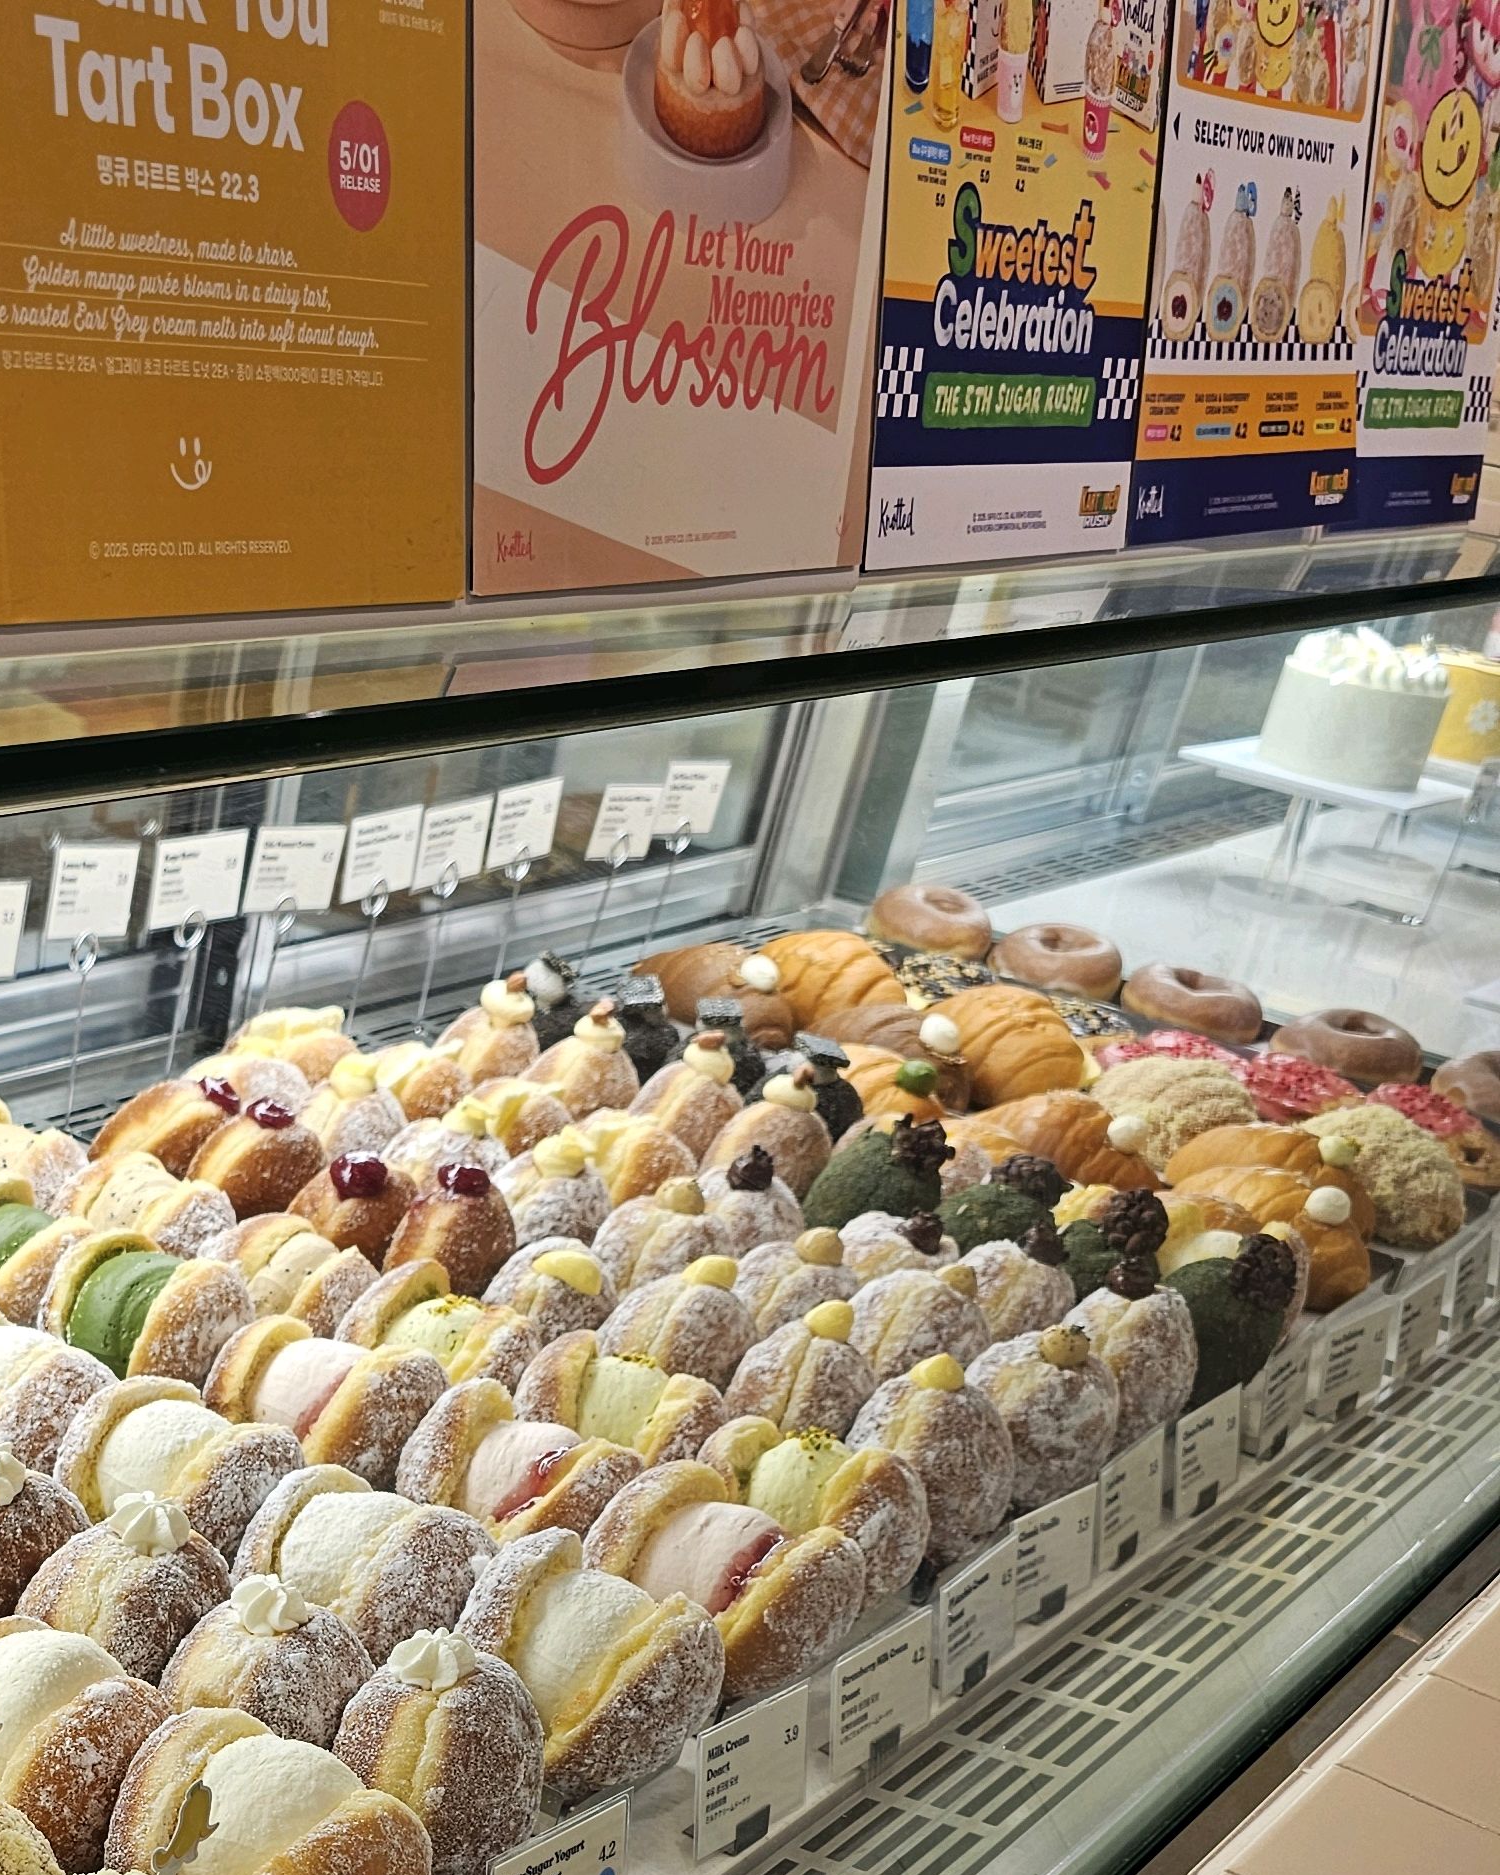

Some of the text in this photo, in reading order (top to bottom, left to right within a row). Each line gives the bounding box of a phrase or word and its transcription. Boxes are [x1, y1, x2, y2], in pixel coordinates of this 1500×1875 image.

[34, 15, 304, 152] Tart Box
[339, 140, 380, 174] 5/01
[1194, 118, 1334, 164] SELECT YOUR OWN DONUT
[97, 155, 260, 203] 땡큐 타르트 박스 22.3
[339, 174, 381, 193] RELEASE
[60, 217, 298, 267] A little sweetness, made to share.
[685, 214, 793, 277] Let Your
[949, 184, 1096, 290] Sweetest
[22, 255, 332, 313] Golden mango purée blooms in a daisy tart,
[706, 275, 834, 328] Memories
[1387, 250, 1470, 326] Sweetest
[11, 303, 71, 328] roasted
[74, 301, 108, 331] Earl
[111, 305, 149, 342] Grey
[153, 315, 197, 337] cream
[200, 316, 237, 340] melts
[239, 318, 267, 341] into
[268, 318, 295, 352] soft
[298, 322, 335, 346] donut
[337, 325, 379, 356] dough.
[933, 279, 1094, 354] Celebration
[24, 351, 54, 370] 타르트
[56, 353, 75, 372] 도넛
[78, 356, 97, 372] 2EA
[144, 357, 161, 376] 초코
[163, 359, 190, 377] 타르트
[193, 361, 209, 379] 도넛
[212, 363, 229, 379] 2EA
[236, 364, 253, 381] 종이
[524, 205, 835, 484] Blossom
[1373, 319, 1467, 377] Celebration
[935, 383, 1090, 416] THE 5TH SUGAR RUSH!
[878, 497, 914, 538] Knotted
[199, 541, 212, 556] ALL
[496, 531, 534, 563] Knotted
[707, 1734, 750, 1762] Milk Cream
[707, 1761, 730, 1782] Donut
[554, 1840, 585, 1863] Yogurt
[598, 1840, 616, 1861] 4.2
